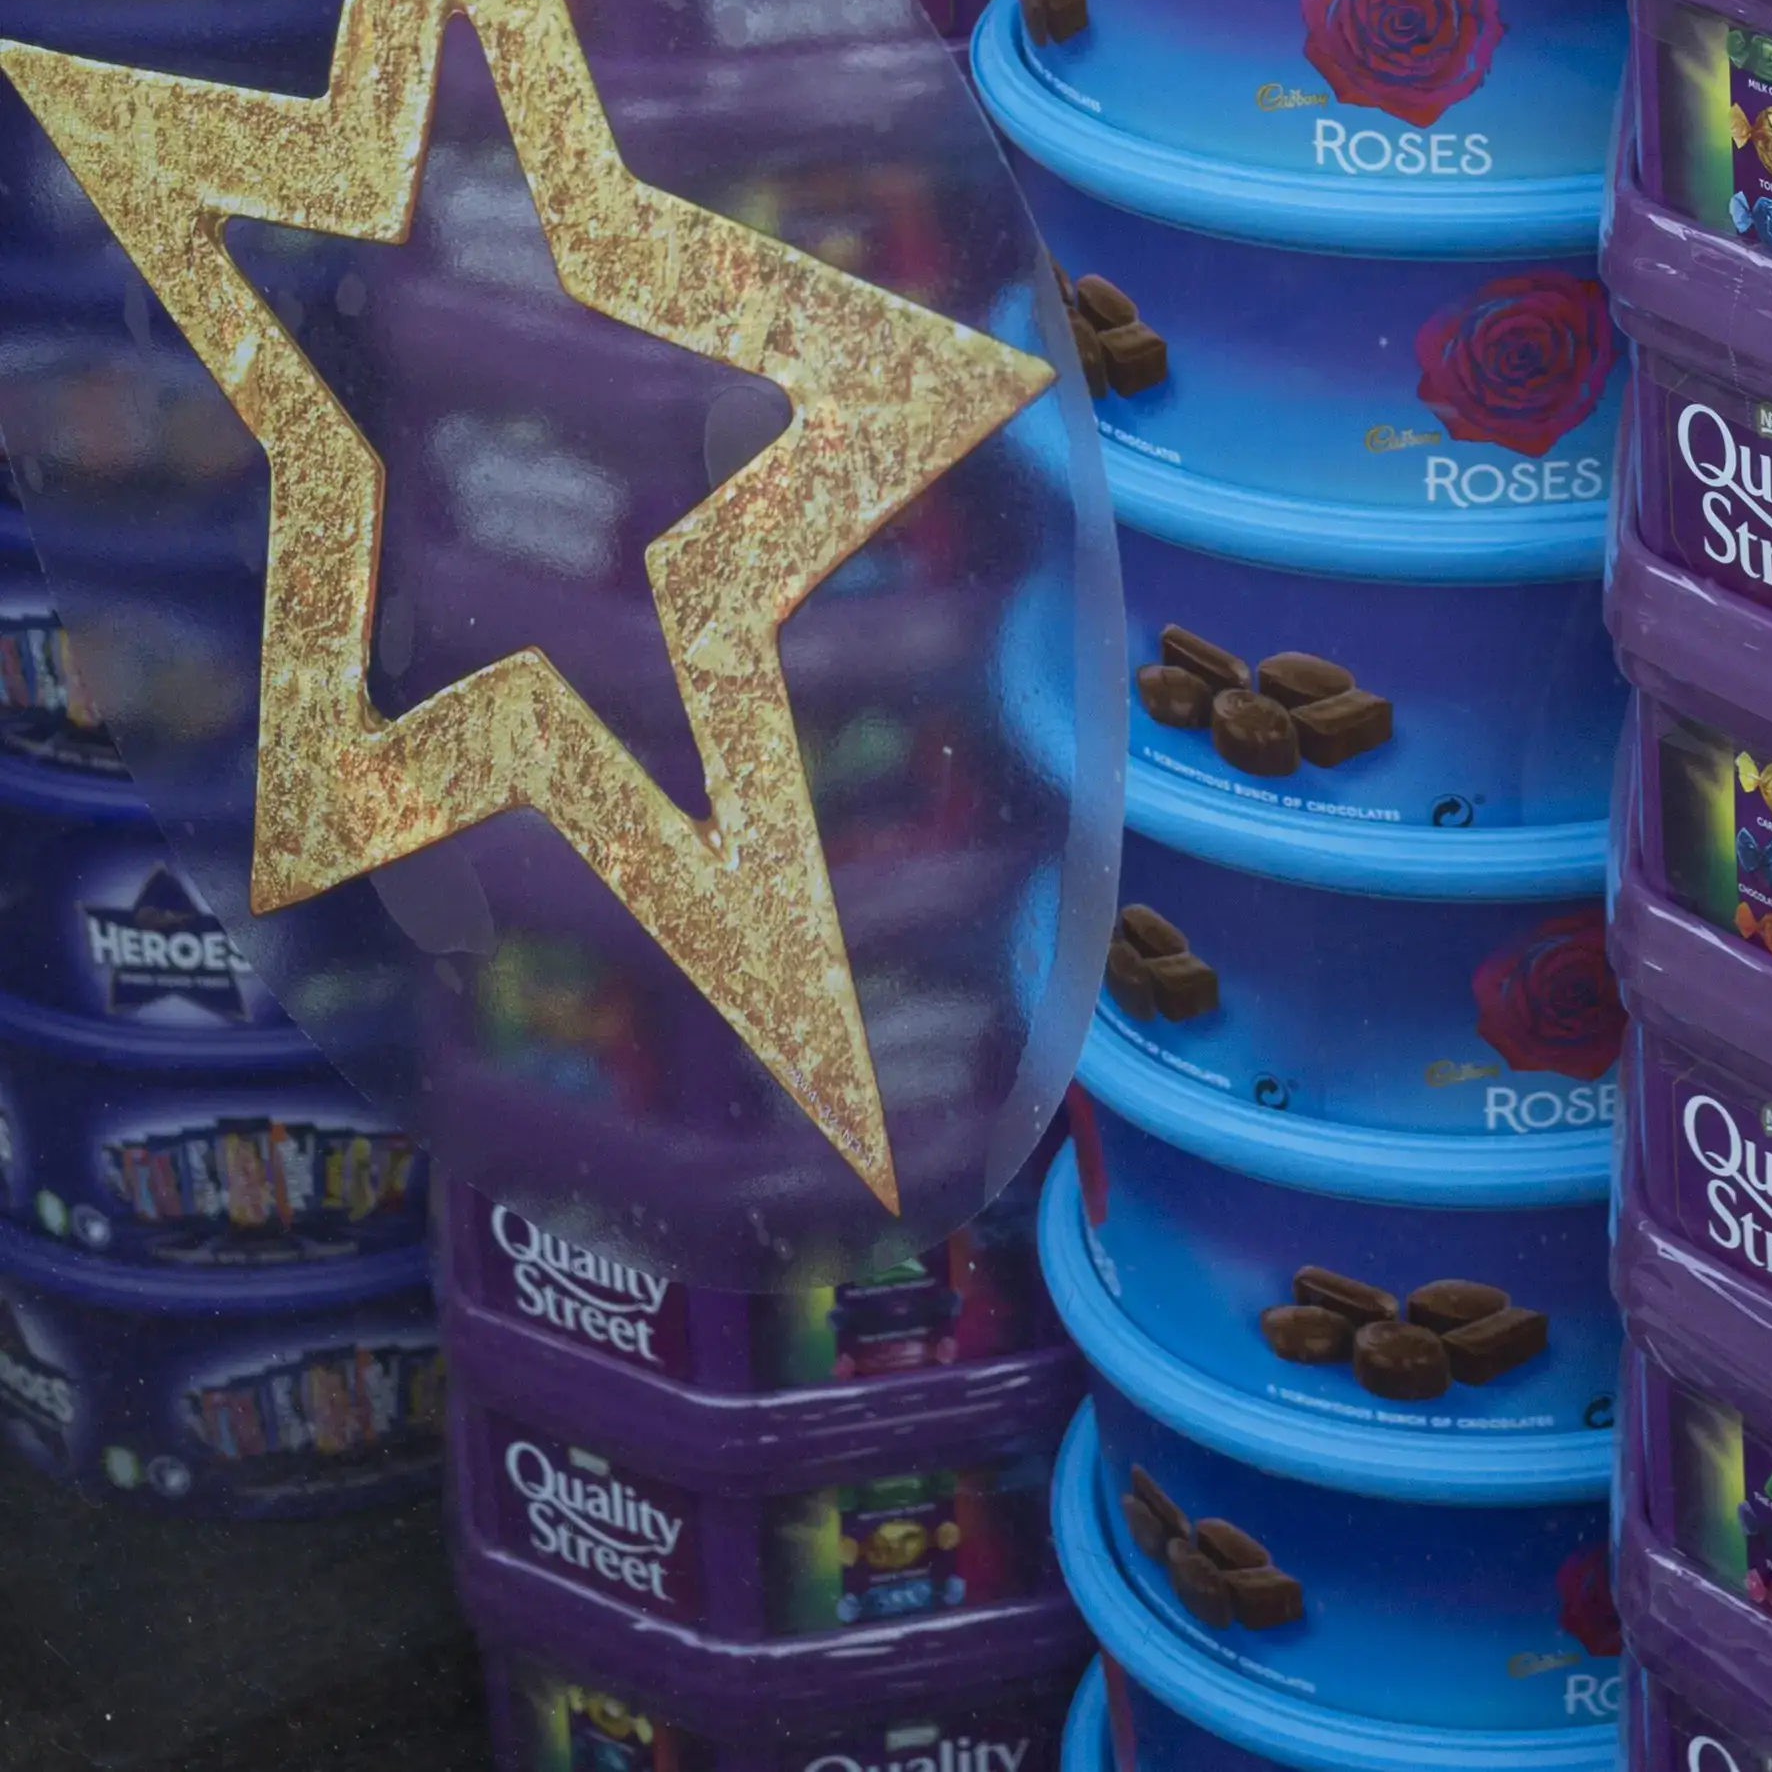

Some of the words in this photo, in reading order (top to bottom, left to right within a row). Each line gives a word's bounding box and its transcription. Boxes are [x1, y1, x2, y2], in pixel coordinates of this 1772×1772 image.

[1256, 82, 1330, 113] Cadbury
[1748, 78, 1769, 94] MILK
[1313, 117, 1493, 176] ROSES
[1424, 456, 1602, 509] ROSES
[1282, 795, 1303, 809] OF
[1306, 800, 1401, 822] CHOCOLATES
[88, 921, 253, 972] HEROES
[491, 1205, 670, 1313] Quality
[513, 1263, 660, 1362] Street
[504, 1440, 683, 1554] Quality
[529, 1503, 675, 1604] Street
